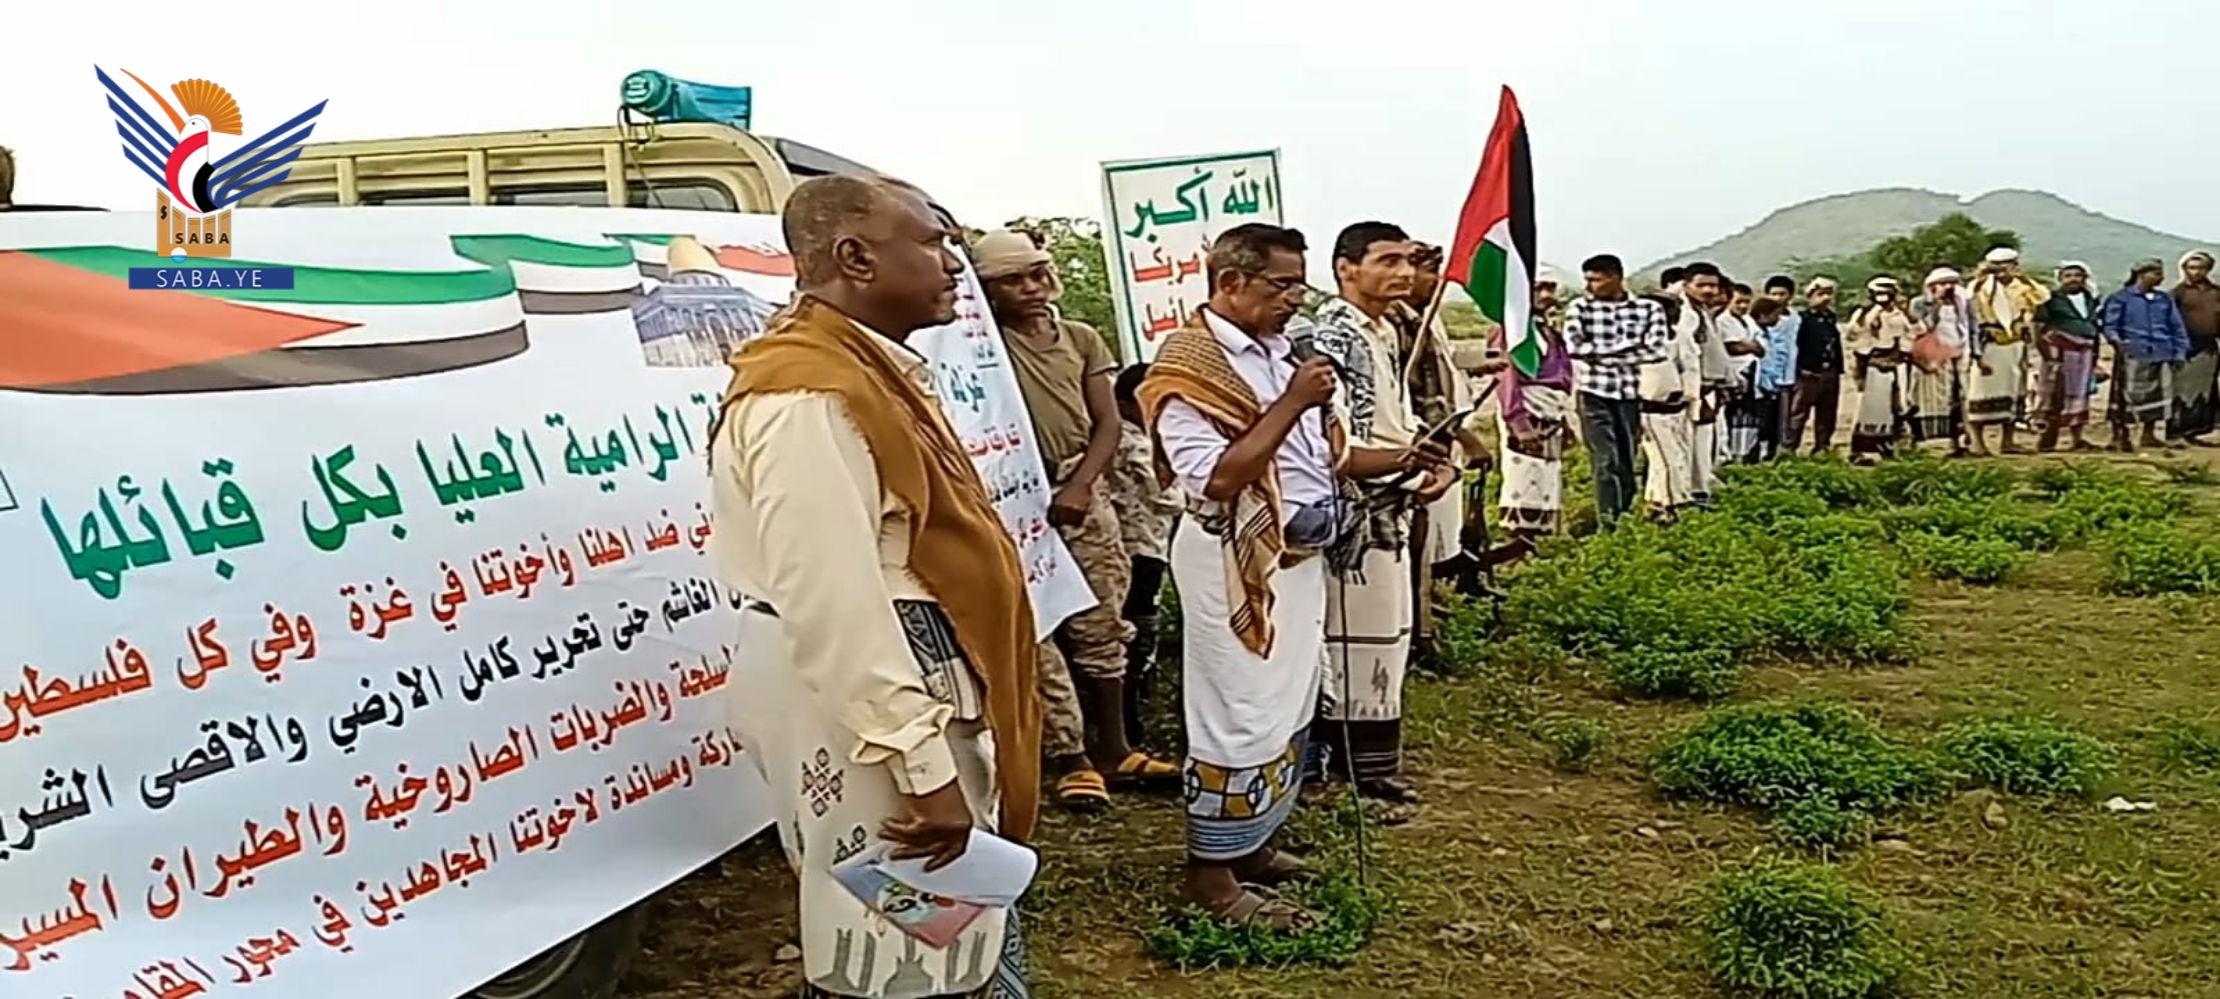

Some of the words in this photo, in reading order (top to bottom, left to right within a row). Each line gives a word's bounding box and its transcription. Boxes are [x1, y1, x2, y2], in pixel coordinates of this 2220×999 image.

[416, 426, 545, 524] العليا
[545, 402, 695, 492] الرامية
[41, 457, 265, 600] قبائلها
[302, 444, 408, 552] بكل
[644, 508, 680, 553] ضد
[472, 533, 575, 599] وأخوتنا
[578, 523, 635, 568] اهلنا
[340, 576, 412, 639] غزة
[431, 561, 468, 632] في
[612, 601, 651, 651] حتى
[177, 618, 228, 690] كل
[251, 603, 316, 683] وفي
[460, 636, 520, 701] كامل
[532, 612, 601, 679] تحرير
[329, 665, 443, 754] الارضي
[550, 678, 672, 752] والضربات
[140, 713, 308, 810] والاقصى
[355, 724, 540, 830] الصاروخية
[605, 754, 692, 811] ومساندة
[509, 787, 599, 854] لاخوتنا
[147, 802, 346, 922] والطيران
[361, 831, 497, 927] المجاهدين
[222, 928, 300, 984] محور
[311, 894, 354, 953] في
